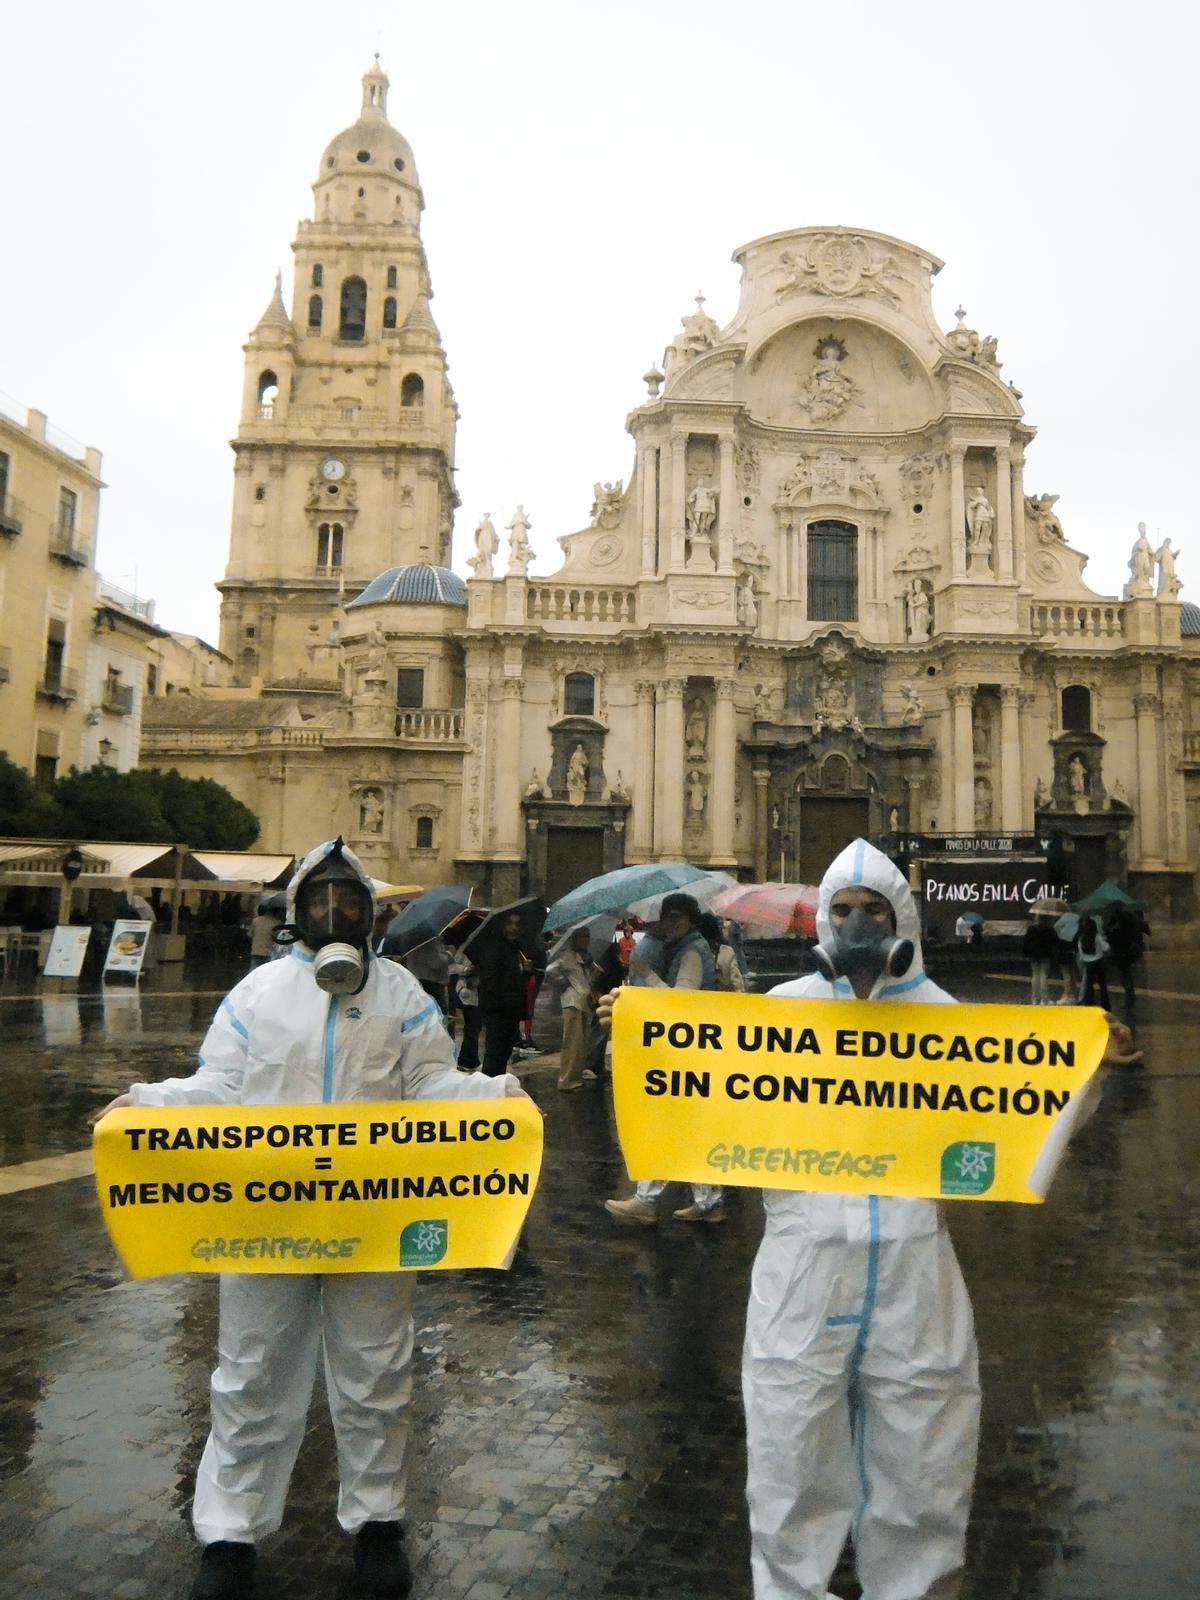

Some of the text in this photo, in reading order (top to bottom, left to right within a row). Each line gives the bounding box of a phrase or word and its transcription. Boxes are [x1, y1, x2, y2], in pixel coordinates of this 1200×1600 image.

[972, 839, 980, 850] LA
[926, 879, 980, 903] PIANOS
[642, 1021, 1076, 1067] POR UNA EDUCACIÓN
[644, 1069, 1071, 1117] SIN CONTAMINACIÓN
[124, 1116, 516, 1151] TRANSPORTE PÚBLICO
[705, 1142, 897, 1178] GREENPEACE
[108, 1168, 530, 1209] MENOS CONTAMINACIÓN
[189, 1235, 363, 1263] GREENPEACE
